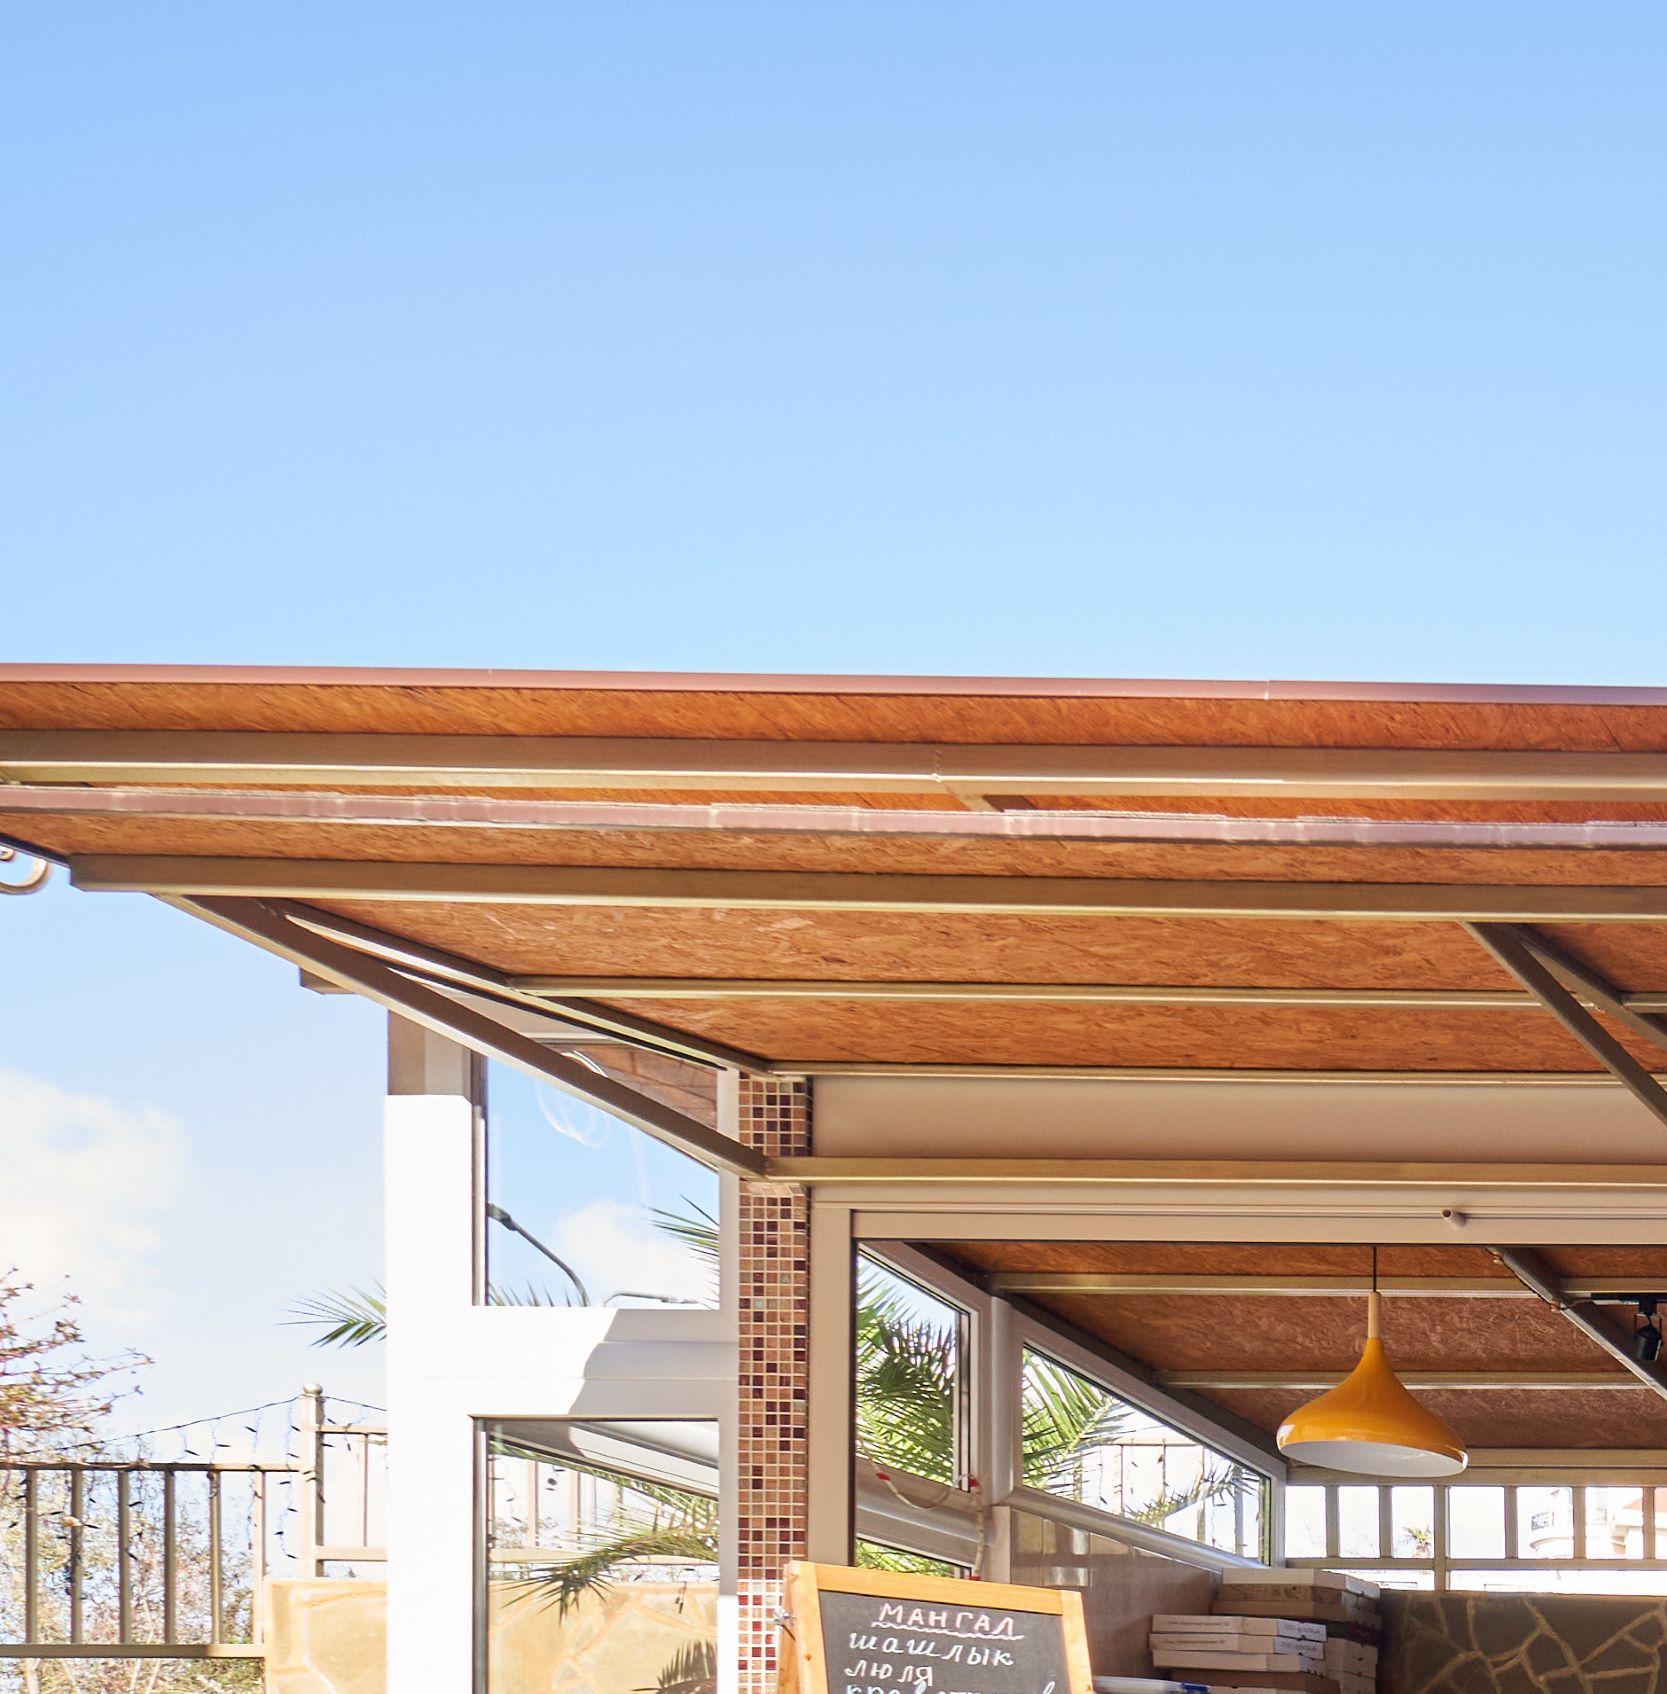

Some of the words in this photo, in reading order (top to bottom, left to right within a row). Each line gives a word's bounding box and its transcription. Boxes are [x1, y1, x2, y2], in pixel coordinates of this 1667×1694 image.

[878, 1602, 1013, 1636] МАНГАЛ
[849, 1632, 1013, 1666] шашлык
[844, 1660, 933, 1686] люля
